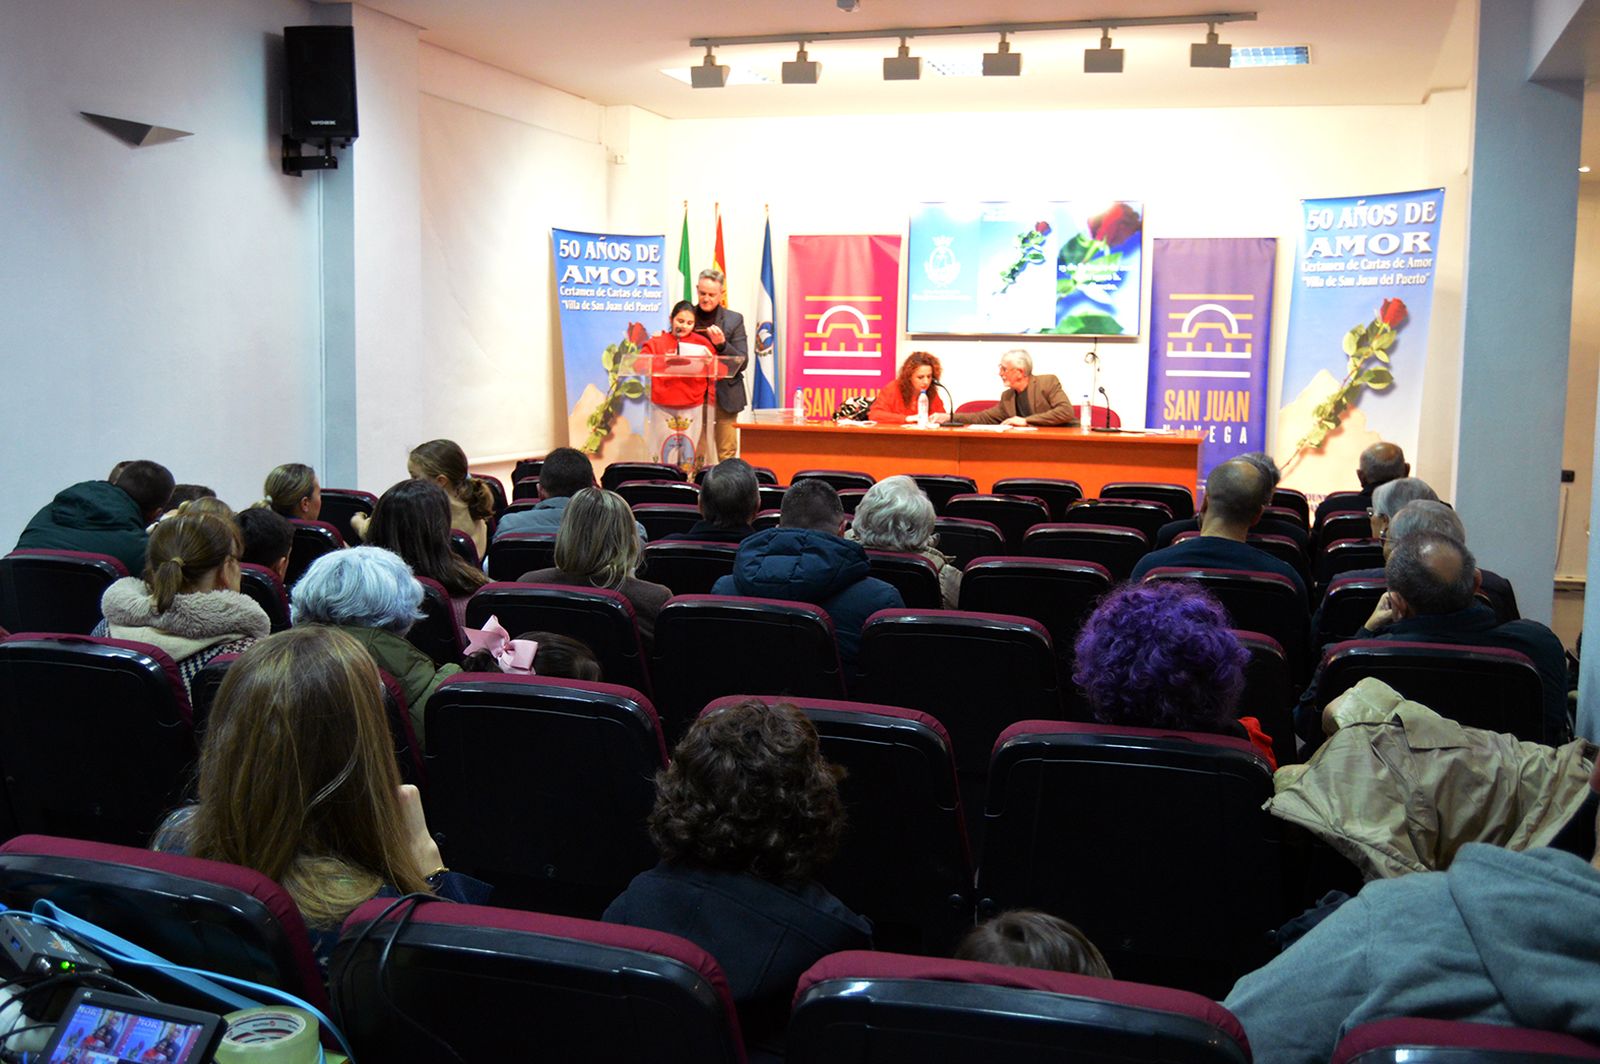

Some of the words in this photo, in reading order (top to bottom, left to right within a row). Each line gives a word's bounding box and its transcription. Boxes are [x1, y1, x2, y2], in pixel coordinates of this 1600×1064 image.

[1306, 208, 1335, 231] 50
[1337, 199, 1398, 229] AÑOS
[1404, 201, 1437, 225] DE
[559, 239, 580, 259] 50
[584, 236, 632, 261] AÑOS
[635, 243, 661, 262] DE
[1304, 231, 1433, 259] AMOR
[560, 264, 661, 287] AMOR
[1346, 259, 1360, 271] de
[1361, 258, 1391, 271] Cartas
[1393, 257, 1405, 270] de
[1407, 256, 1432, 269] Amor
[1325, 276, 1338, 287] de
[1338, 275, 1355, 287] San
[1356, 274, 1379, 287] Juan
[1379, 273, 1394, 286] del
[559, 286, 595, 297] Certamen
[596, 287, 607, 298] de
[607, 287, 631, 299] Cartas
[632, 288, 643, 299] de
[581, 300, 591, 312] de
[591, 300, 605, 312] San
[606, 301, 623, 312] Juan
[624, 301, 635, 313] del
[803, 387, 836, 418] SAN
[1163, 389, 1200, 422] SAN
[1203, 389, 1250, 423] JUAN
